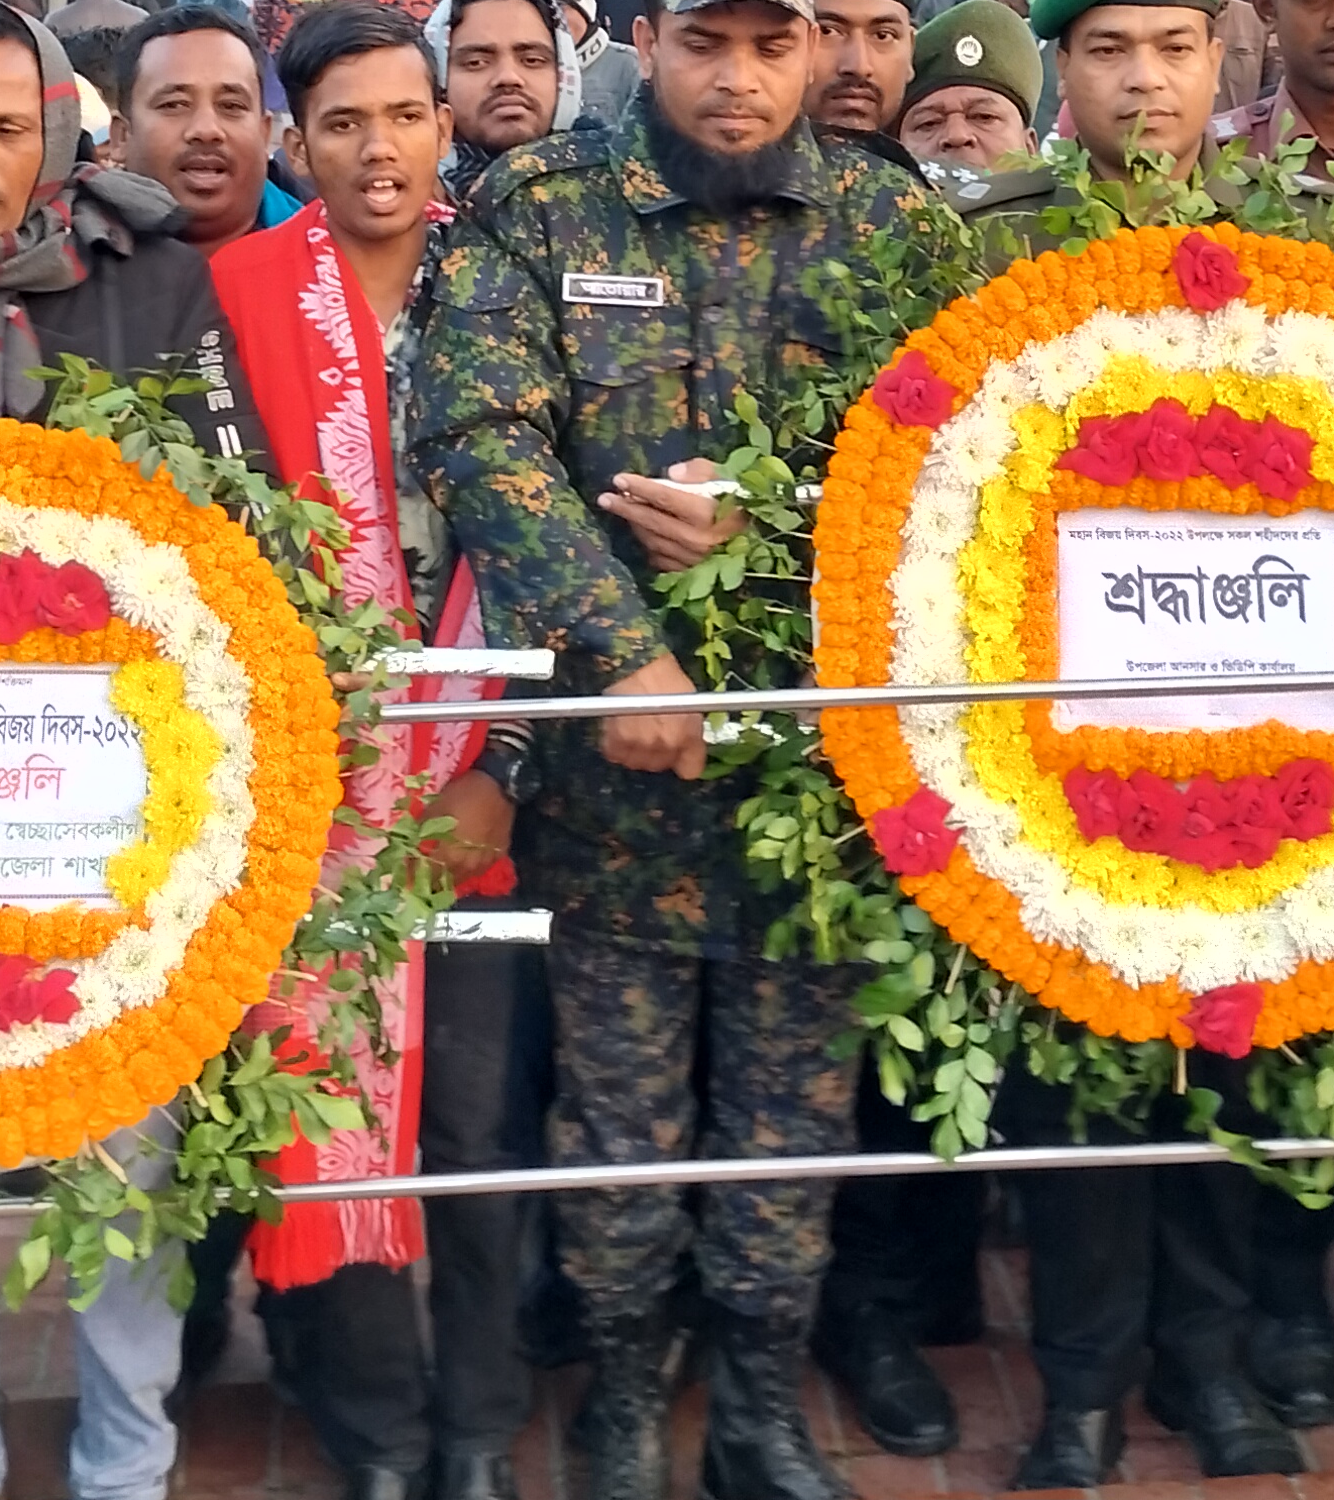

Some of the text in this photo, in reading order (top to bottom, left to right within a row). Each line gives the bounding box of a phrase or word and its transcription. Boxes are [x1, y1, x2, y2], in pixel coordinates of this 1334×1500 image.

[1068, 529, 1093, 541] মহান
[1095, 526, 1122, 540] বিজয়
[1124, 526, 1185, 542] দিবস-২০২২
[1186, 529, 1224, 541] উপলক্ষে
[1227, 530, 1252, 541] সকল
[1301, 526, 1322, 541] প্রতি
[1101, 554, 1311, 625] শ্রদ্ধাঞ্জলি
[1126, 659, 1166, 672] উপজেলা
[1169, 661, 1207, 672] আনসার
[1210, 662, 1219, 672] ও
